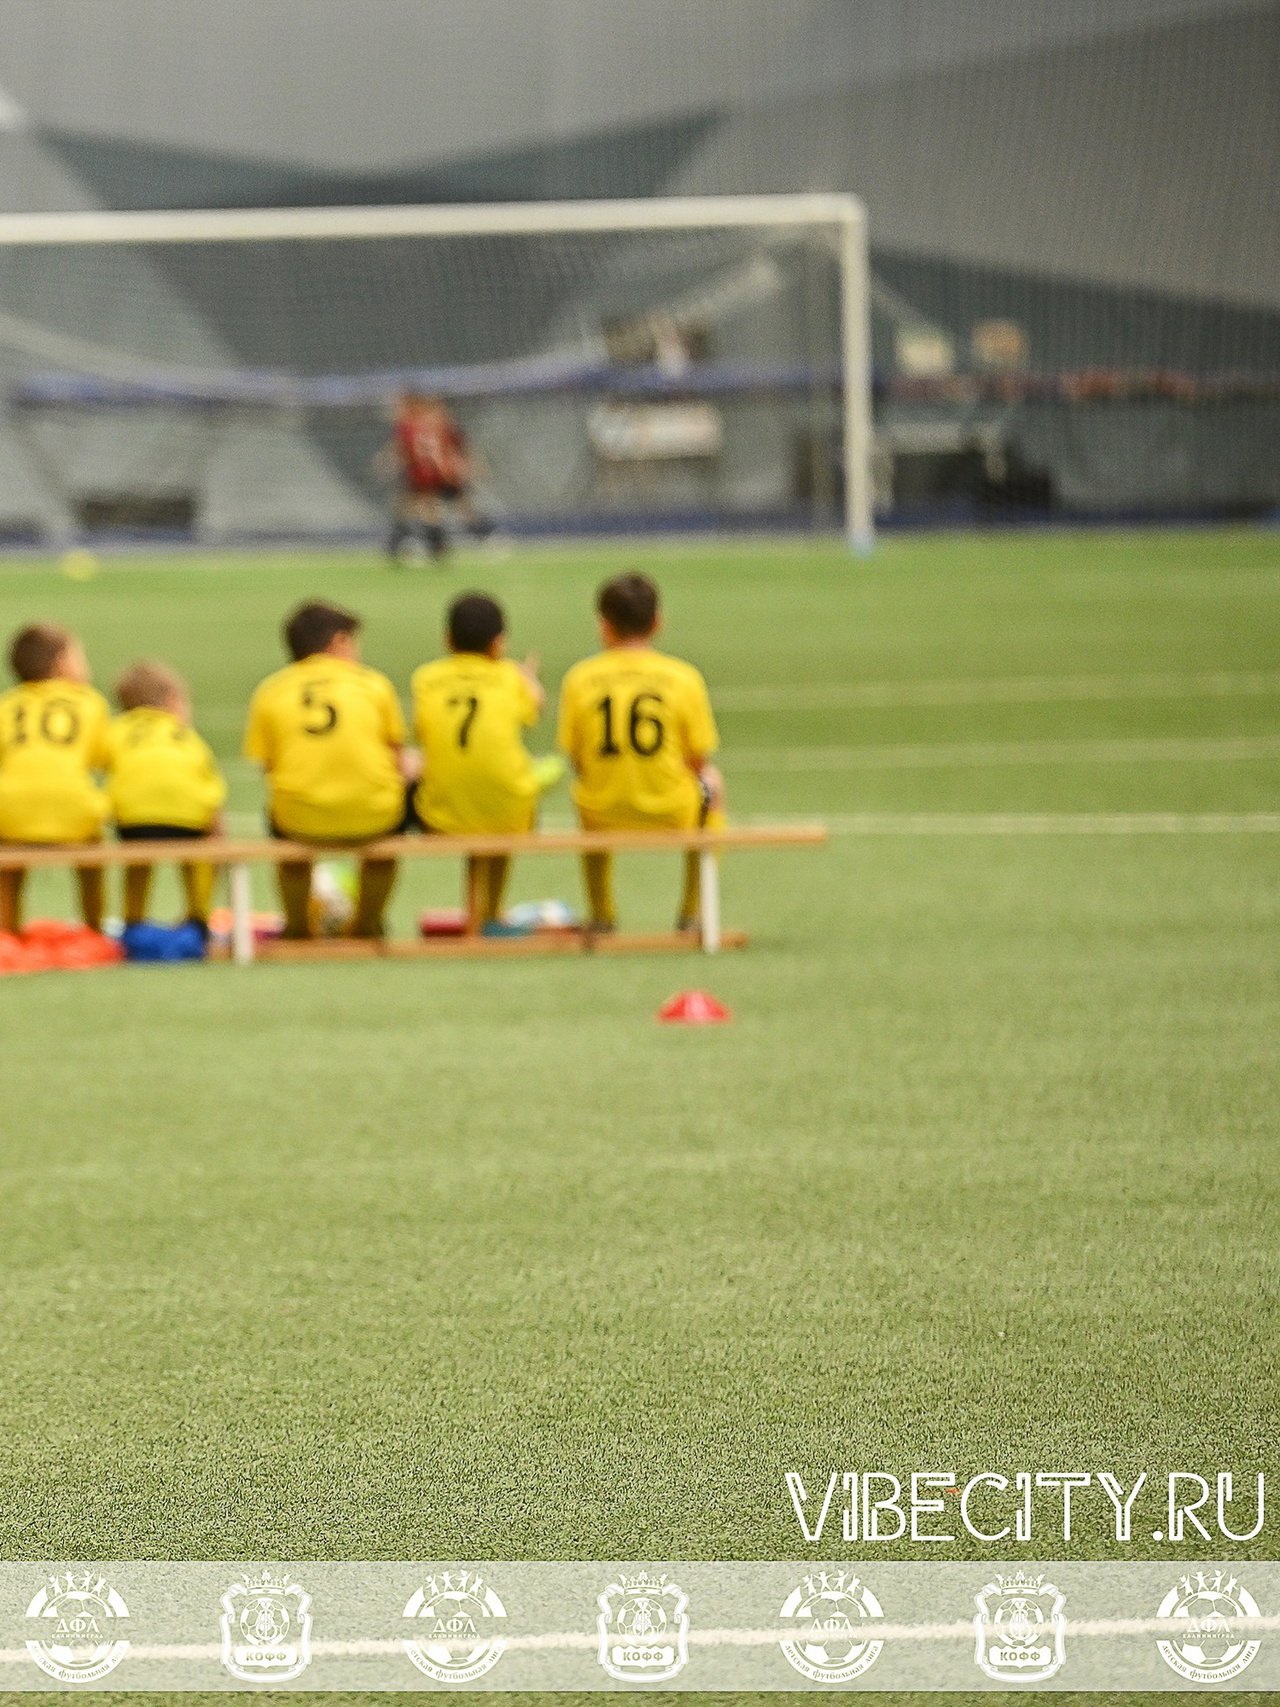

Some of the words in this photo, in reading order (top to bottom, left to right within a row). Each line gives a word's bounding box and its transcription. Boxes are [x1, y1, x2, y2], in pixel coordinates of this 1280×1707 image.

[13, 699, 79, 747] 10
[301, 680, 339, 736] 5
[447, 694, 480, 749] 7
[597, 692, 665, 758] 16
